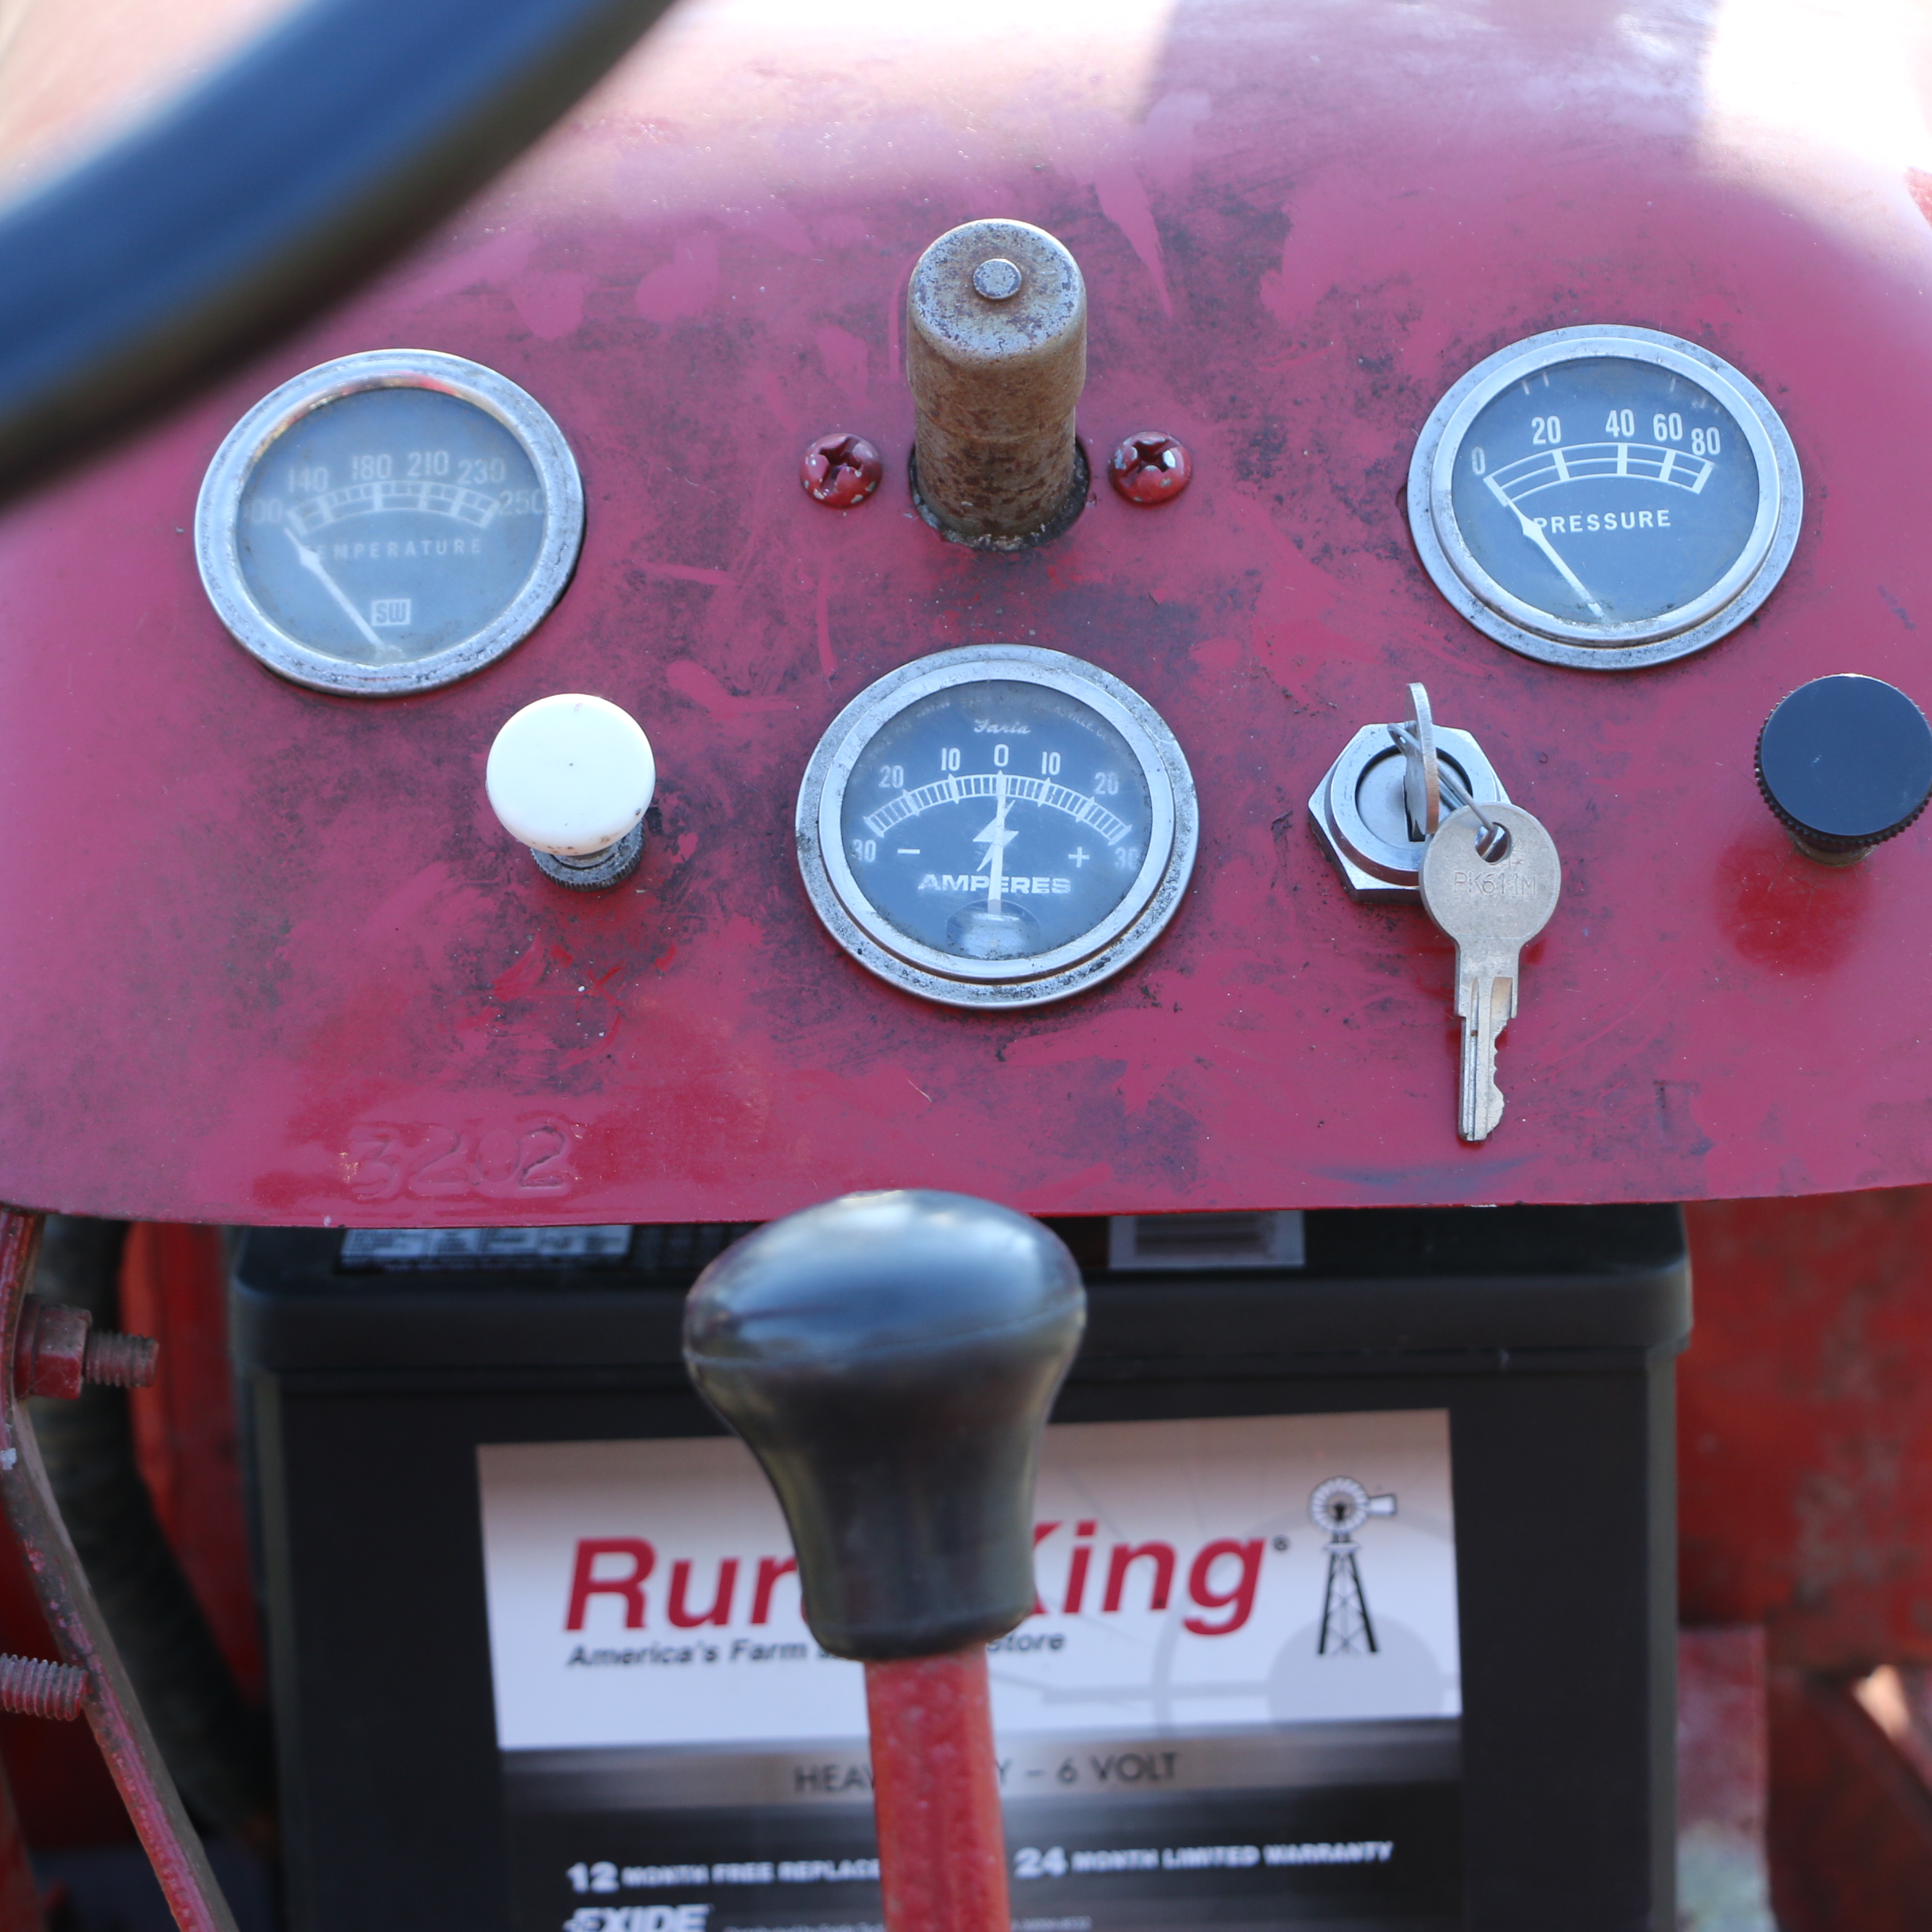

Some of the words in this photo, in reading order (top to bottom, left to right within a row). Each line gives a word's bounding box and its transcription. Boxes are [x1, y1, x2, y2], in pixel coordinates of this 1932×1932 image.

[1471, 446, 1486, 474] 0
[1532, 415, 1561, 444] 20
[1605, 408, 1635, 438] 40
[1653, 412, 1683, 441] 60
[1691, 427, 1721, 456] 80
[288, 466, 329, 494] 140
[352, 454, 393, 481] 180
[407, 450, 449, 477] 210
[458, 457, 506, 485] 230
[1533, 509, 1671, 534] PRESSURE
[376, 601, 406, 624] SW
[973, 718, 1032, 735] Faria
[852, 840, 877, 863] 30
[878, 764, 905, 788] 20
[941, 747, 961, 771] 10
[994, 744, 1010, 767] 0
[1041, 751, 1061, 775] 10
[1094, 771, 1119, 795] 20
[1115, 847, 1139, 870] 30
[918, 873, 1072, 895] AMPERES
[566, 1640, 717, 1668] America's
[730, 1638, 809, 1663] Farm
[1057, 1756, 1078, 1786] 6
[1091, 1752, 1177, 1784] VOLT
[566, 1860, 620, 1894] 12
[621, 1864, 710, 1888] MONTH
[711, 1861, 775, 1886] FREE
[1014, 1845, 1068, 1880] 24
[1071, 1848, 1159, 1875] MONTH
[1161, 1844, 1259, 1871] LIMITED
[1263, 1839, 1394, 1868] WARRANTY
